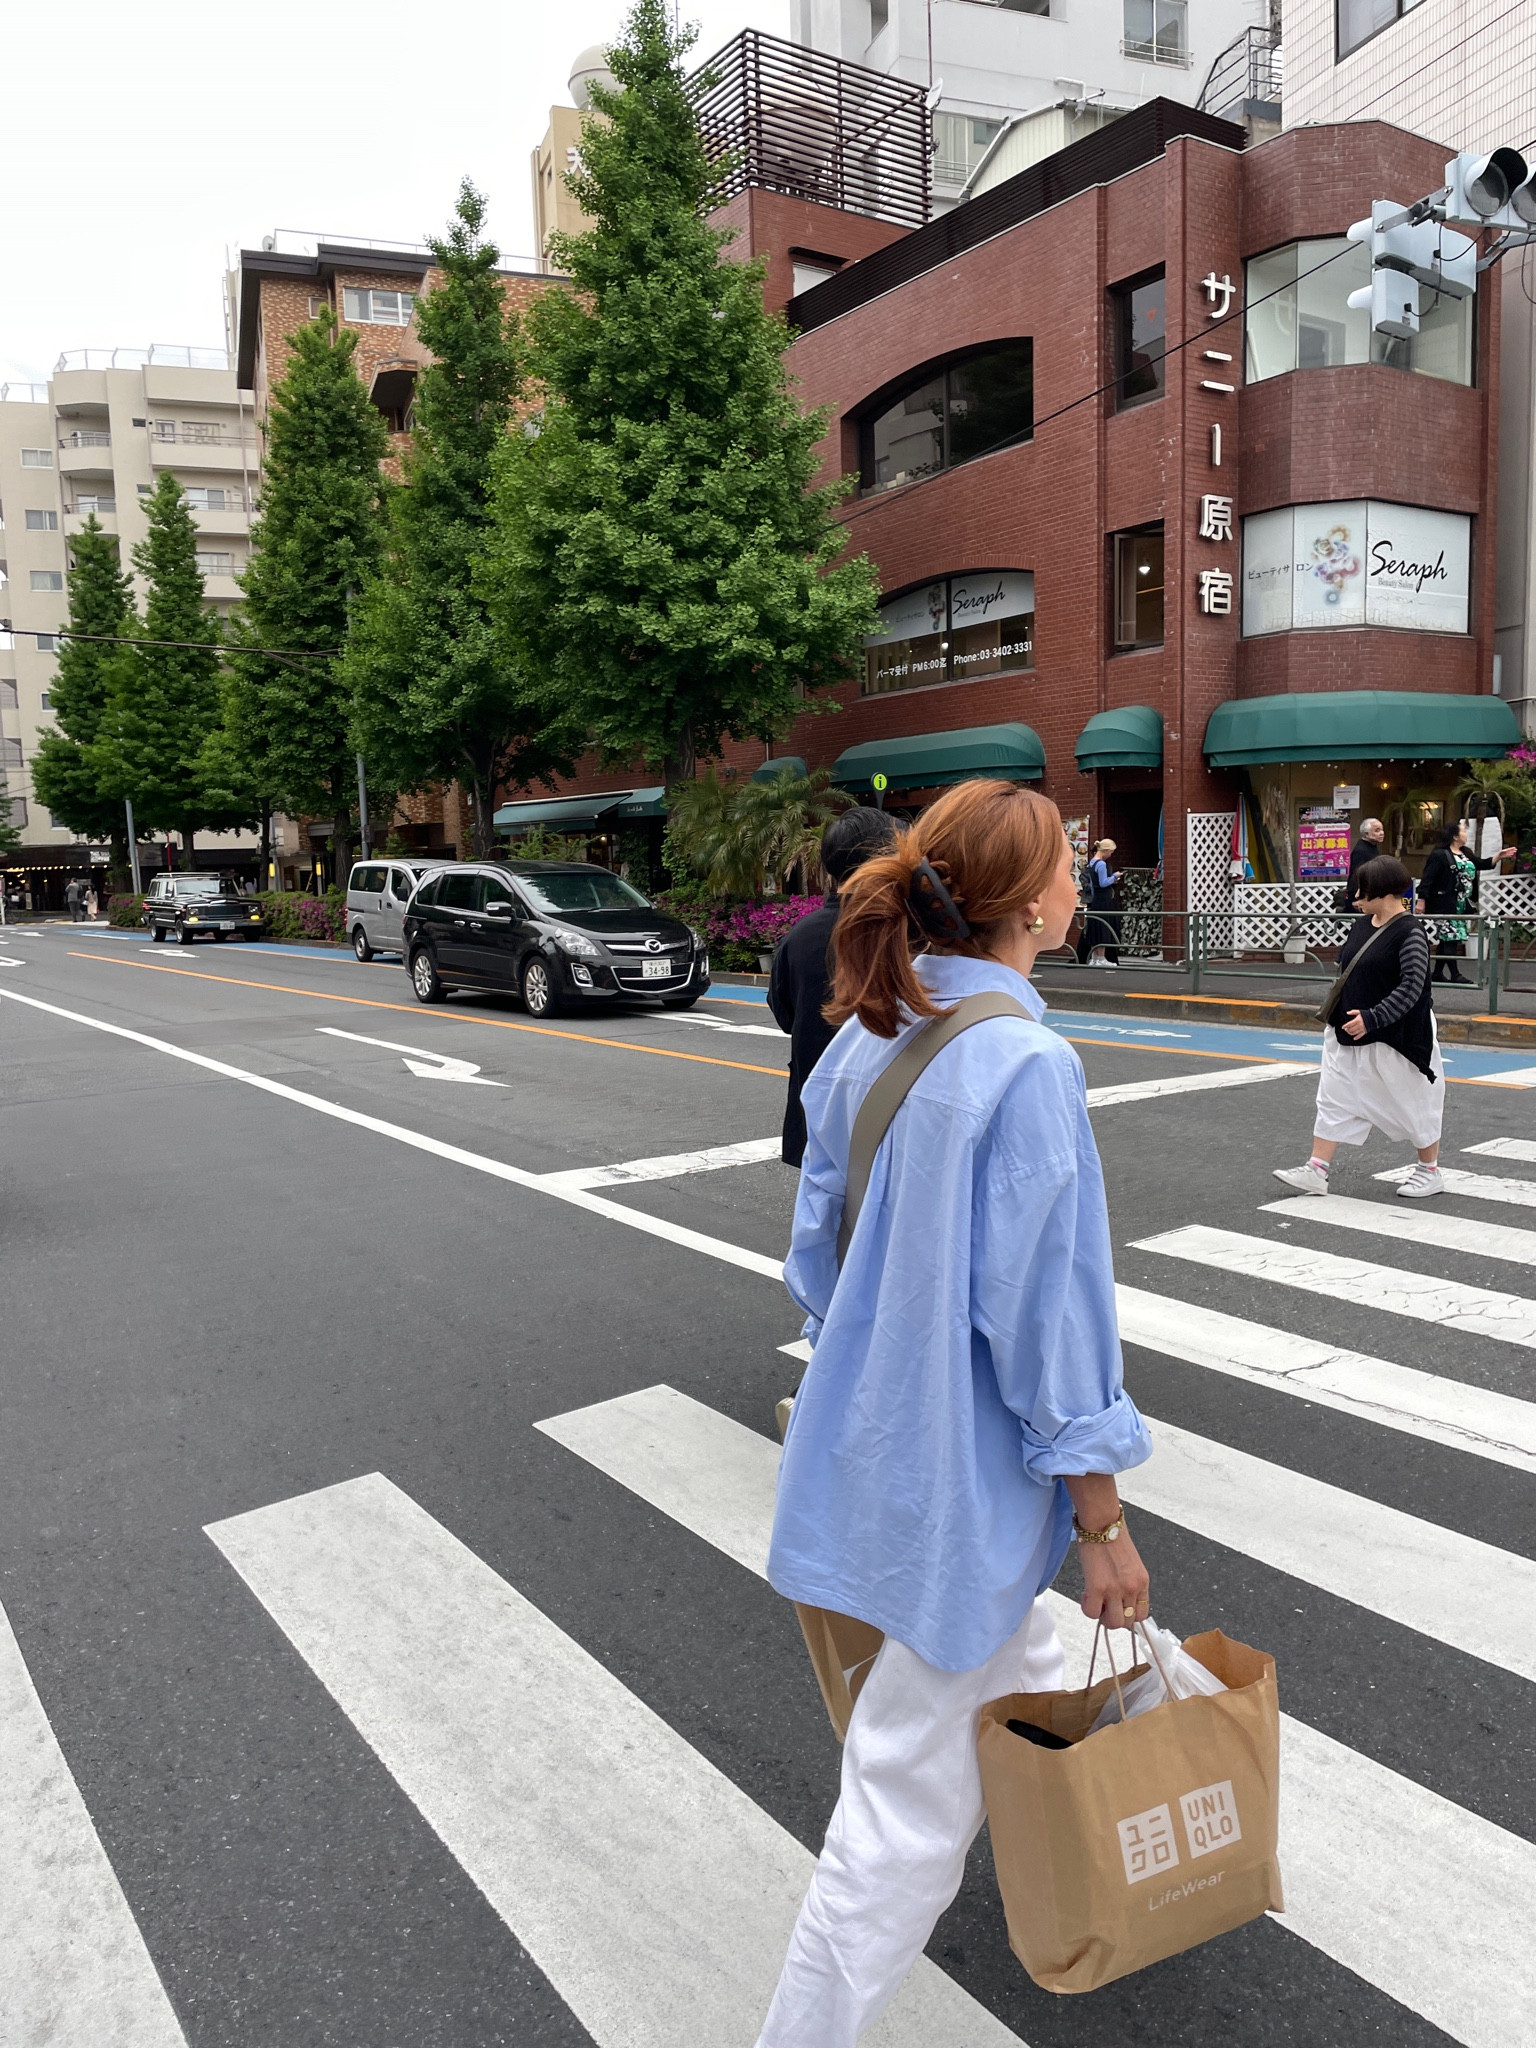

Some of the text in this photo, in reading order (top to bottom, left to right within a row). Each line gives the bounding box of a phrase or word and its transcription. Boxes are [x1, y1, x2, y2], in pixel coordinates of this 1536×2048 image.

[1200, 272, 1236, 615] サニー原宿
[1371, 540, 1448, 593] Seraph
[952, 580, 1006, 614] Seraph
[953, 640, 1033, 665] Phone:03-3402-3331
[1187, 1790, 1225, 1821] UNI
[1193, 1815, 1233, 1849] QLO
[1148, 1870, 1226, 1911] LifeWear
